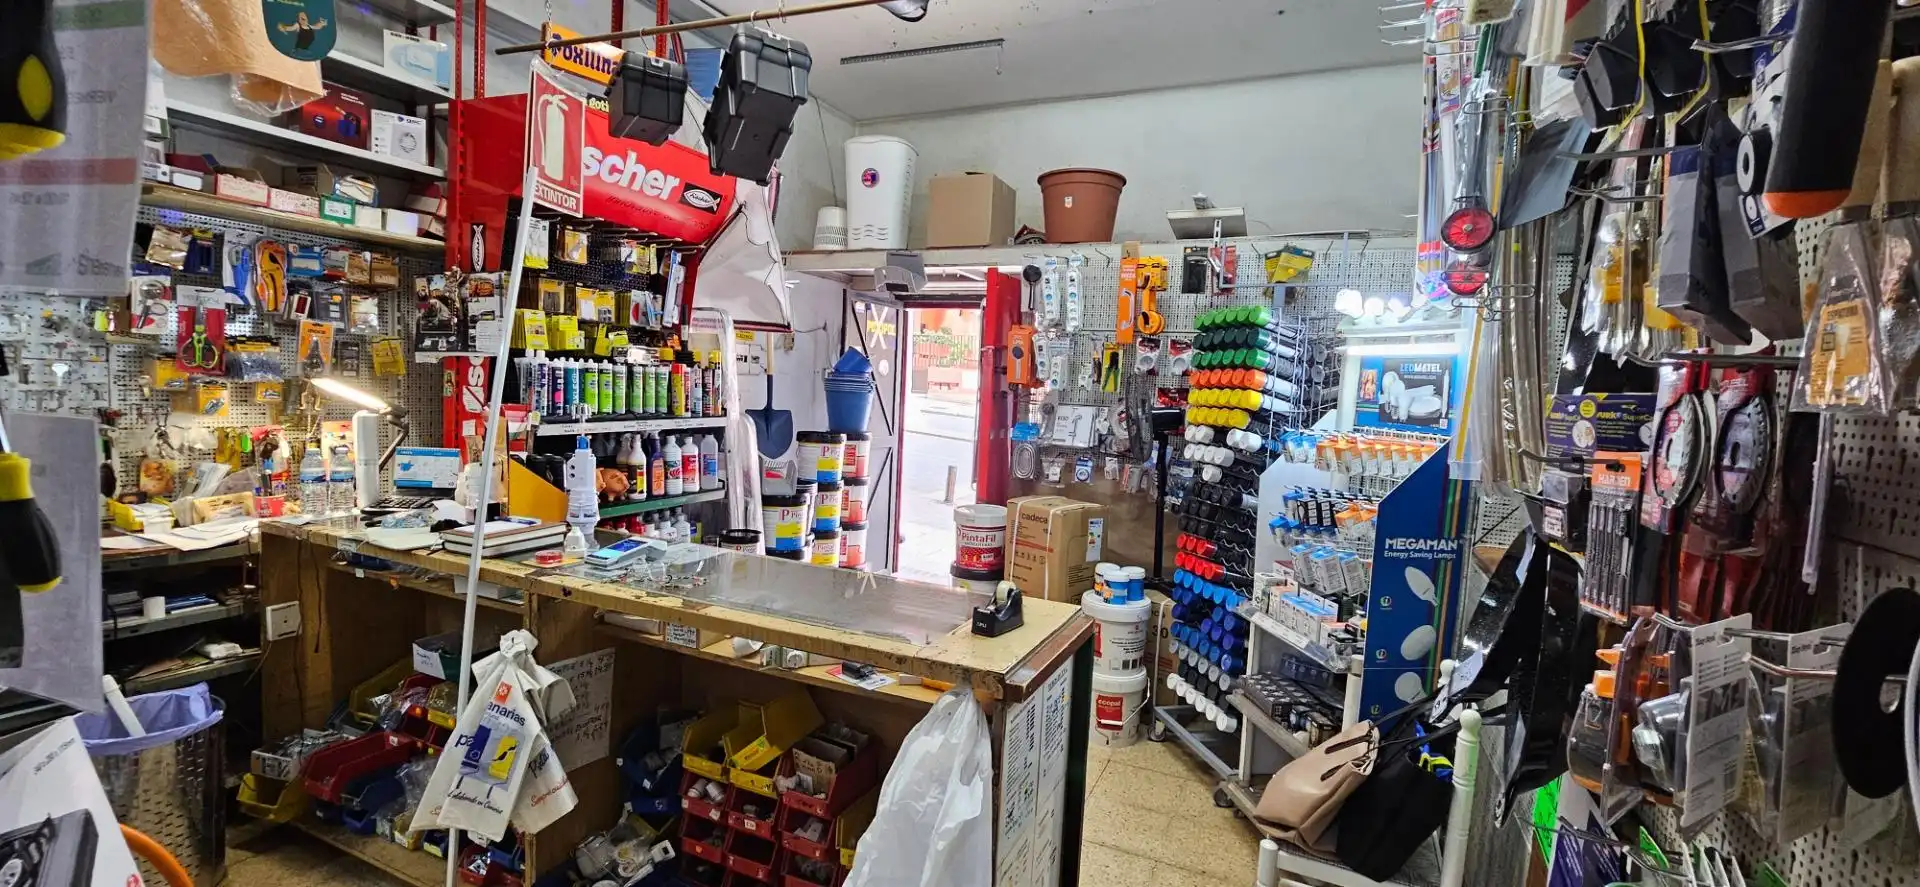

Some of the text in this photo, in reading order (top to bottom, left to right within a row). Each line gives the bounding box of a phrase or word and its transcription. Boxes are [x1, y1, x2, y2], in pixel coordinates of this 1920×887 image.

[582, 146, 680, 200] scher
[534, 184, 577, 210] EXTINTOR
[1400, 363, 1442, 373] LEDMATEL
[1385, 537, 1458, 550] MEGAMAN
[1384, 550, 1456, 559] Energy Saving Lamps
[487, 701, 526, 727] anarias
